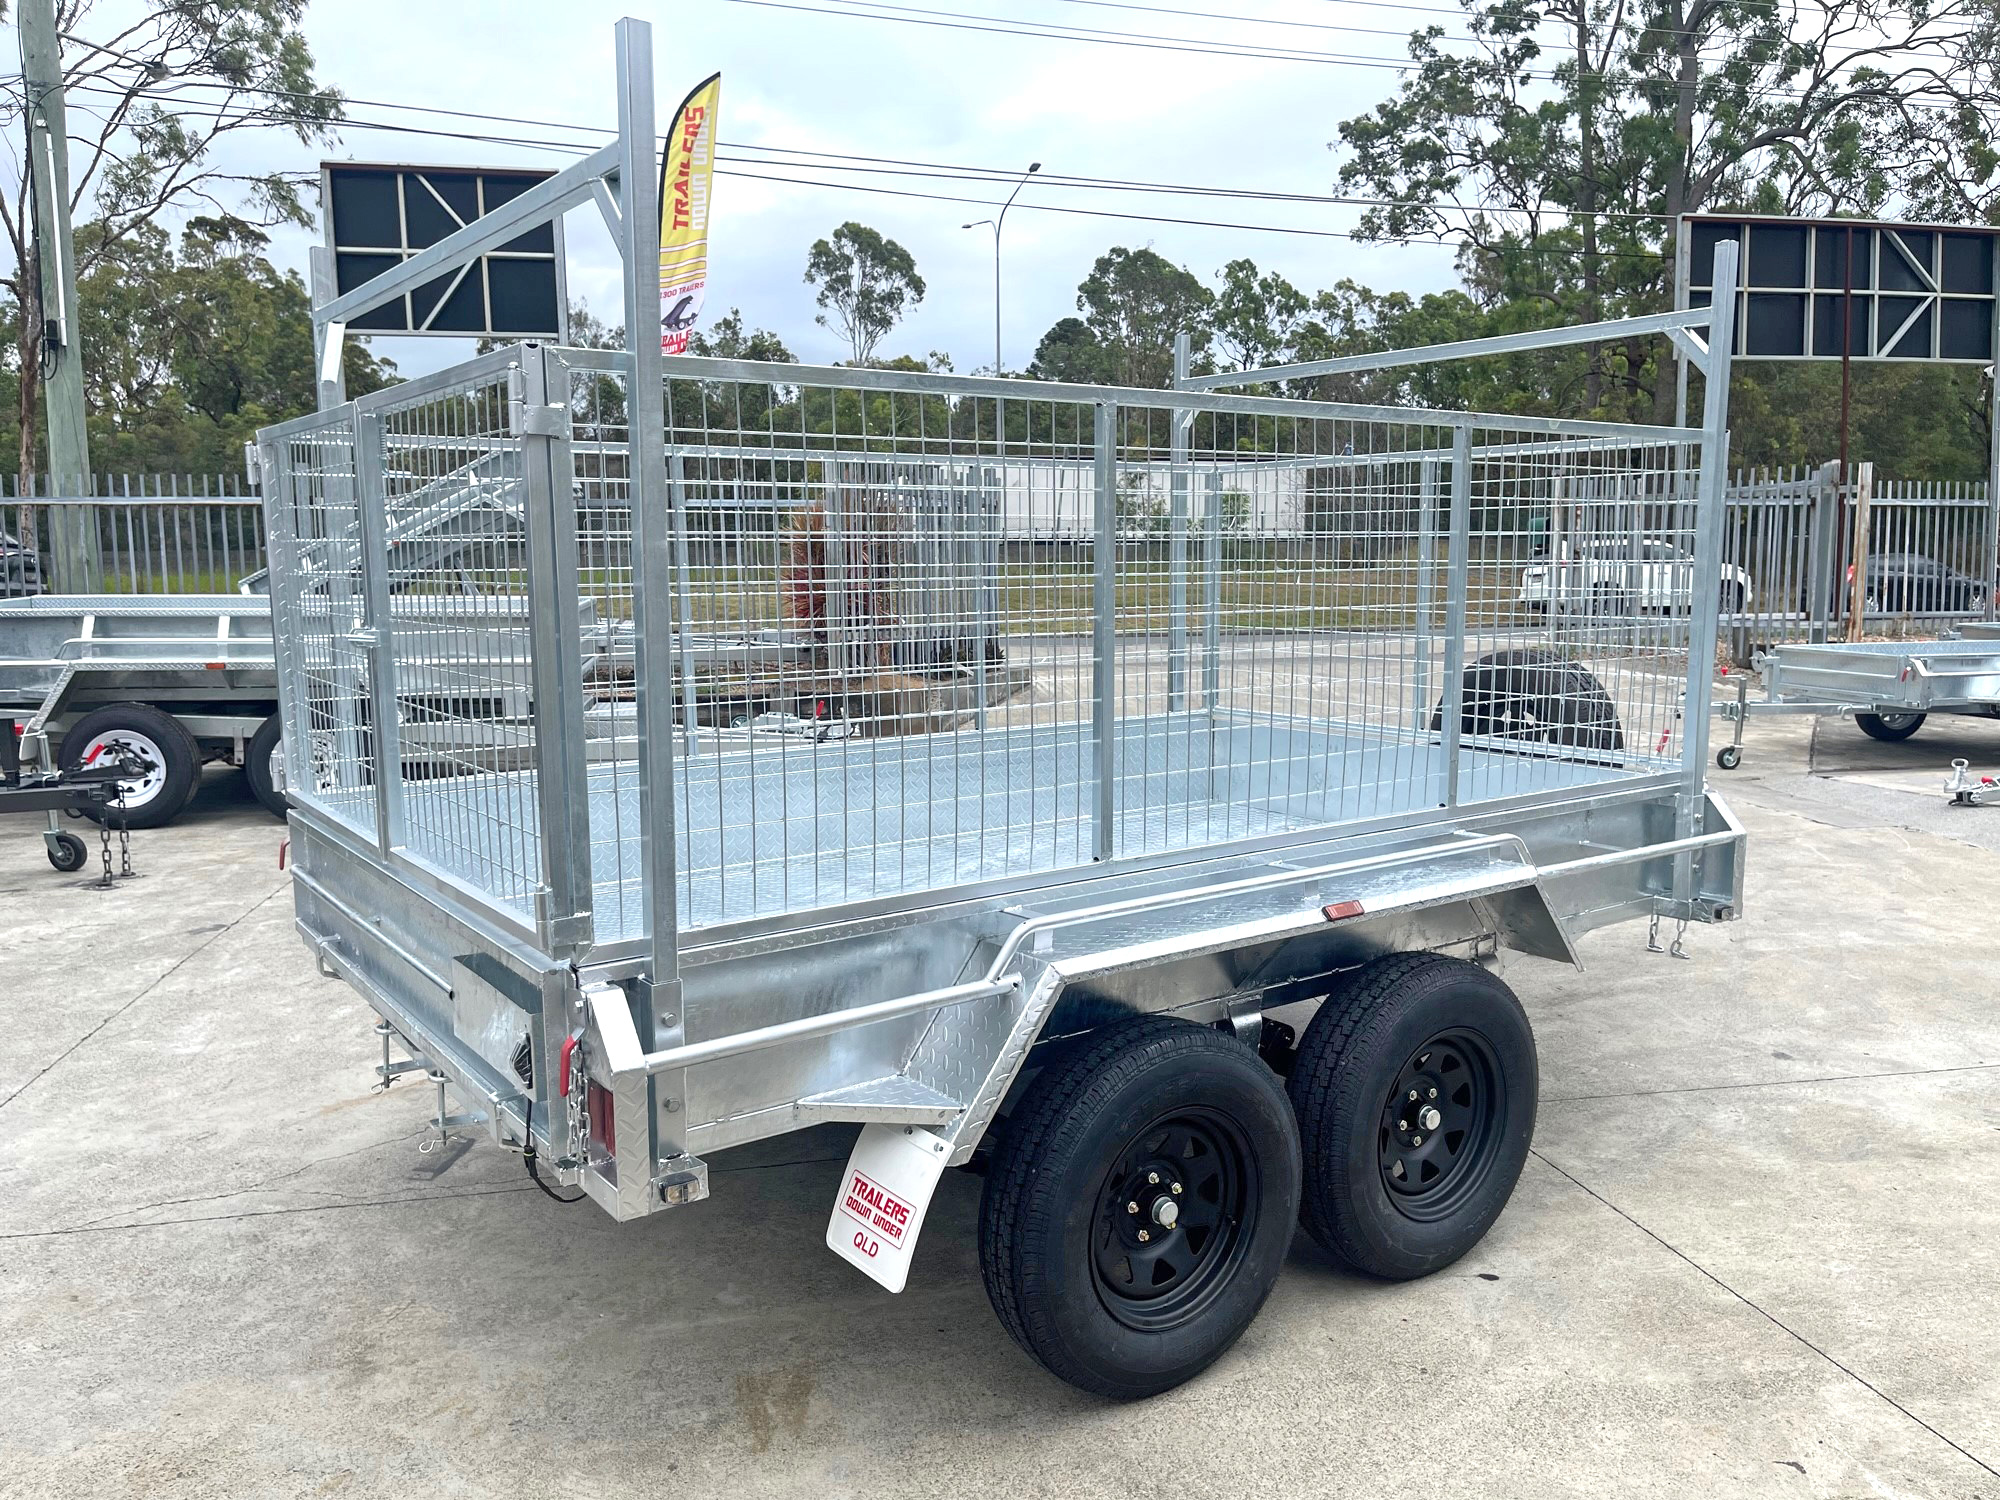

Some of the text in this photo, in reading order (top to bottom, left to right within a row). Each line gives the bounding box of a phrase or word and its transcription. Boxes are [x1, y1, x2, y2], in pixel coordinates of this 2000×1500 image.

[672, 106, 705, 231] TRAILERS
[691, 173, 707, 231] DOWN
[845, 1195, 903, 1240] DOWN UNDER
[852, 1176, 910, 1225] TRAILERS
[853, 1231, 879, 1258] QLD
